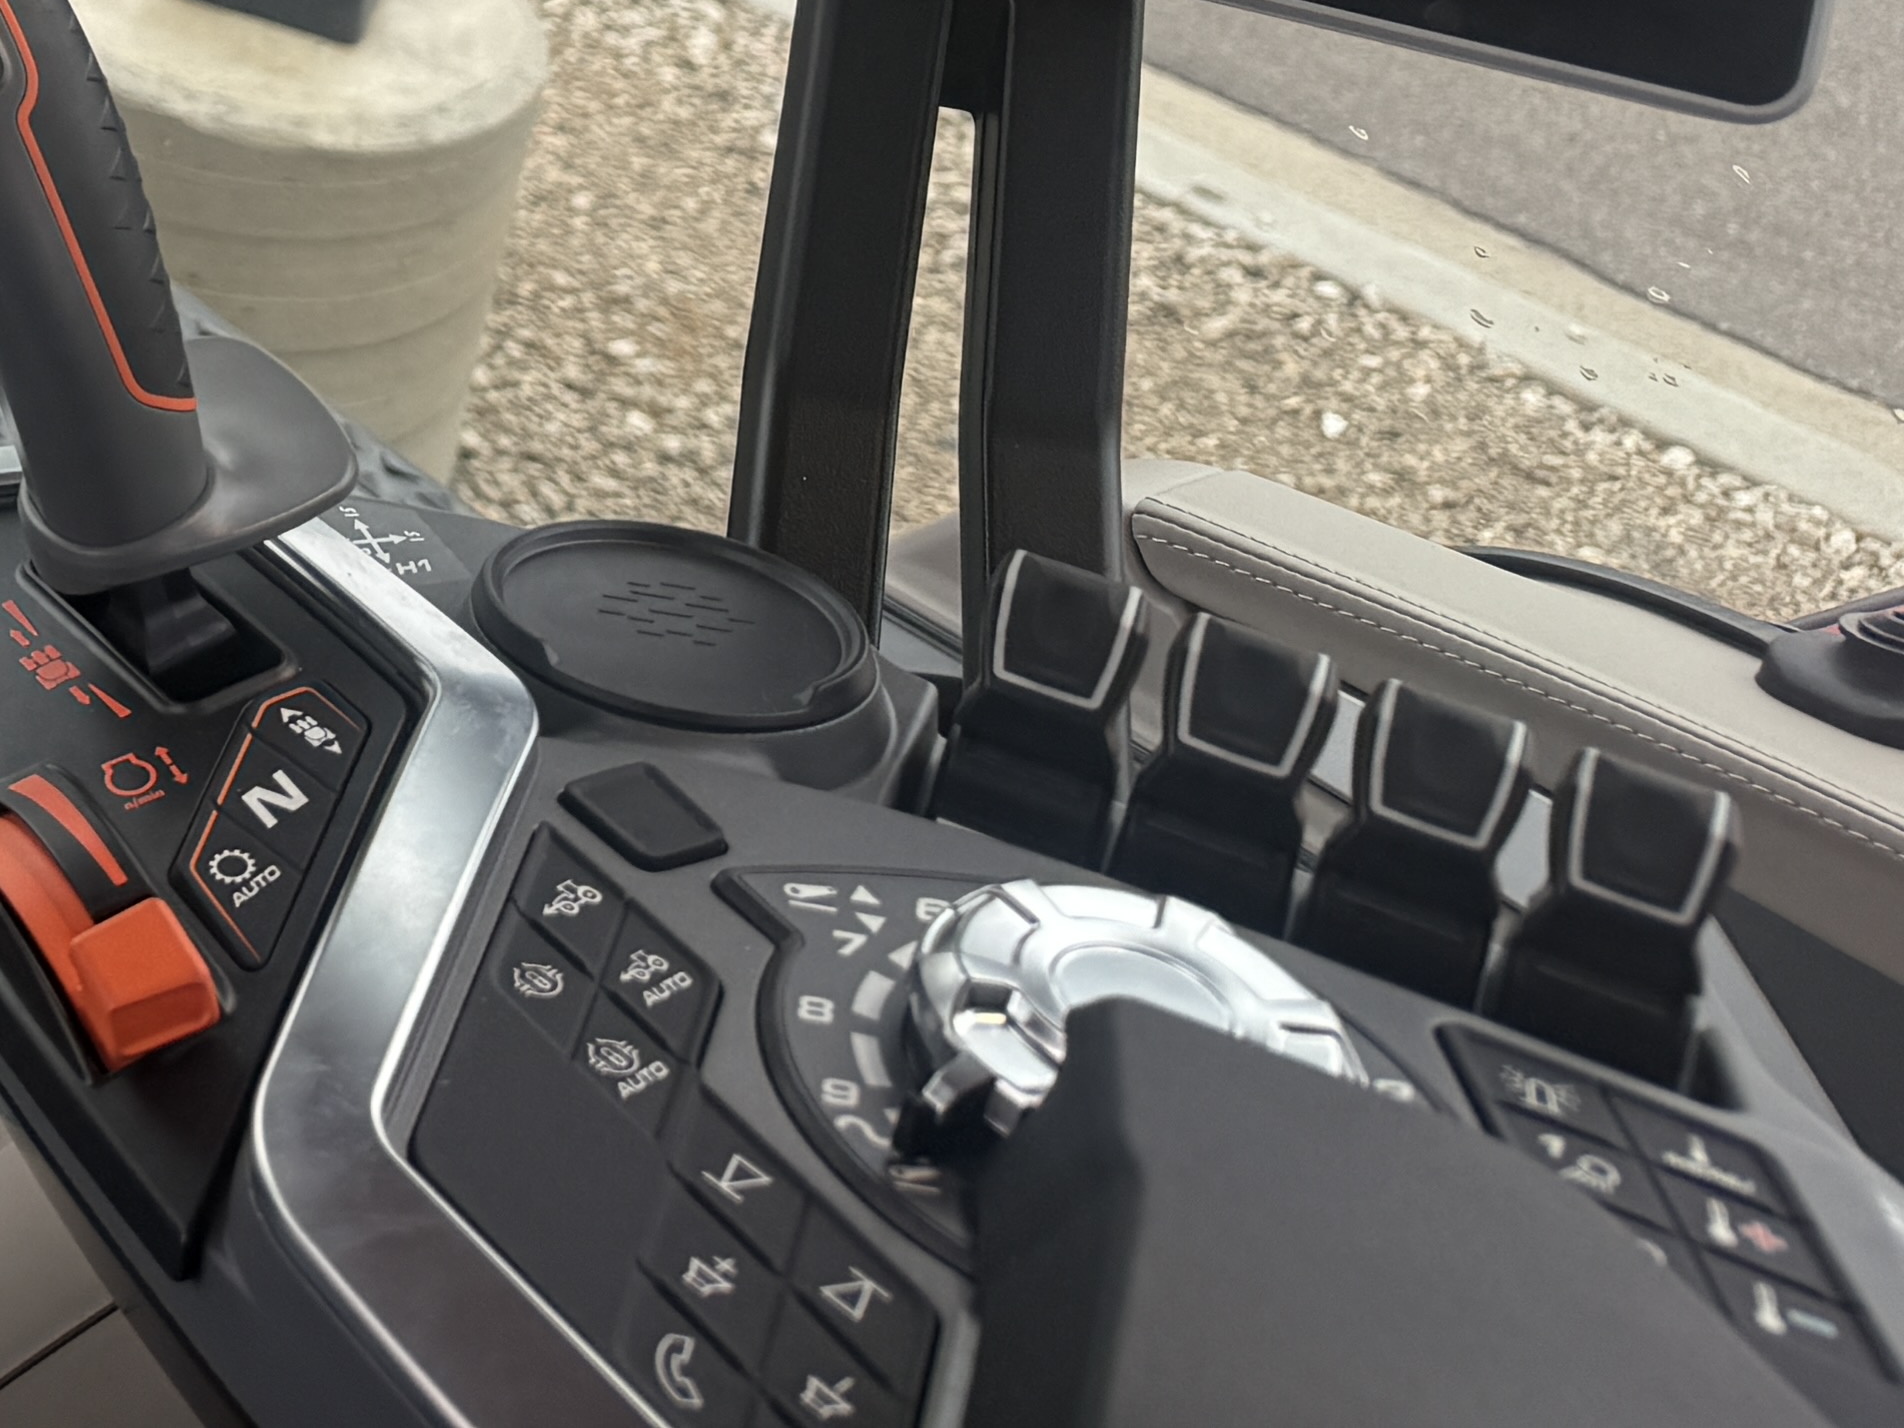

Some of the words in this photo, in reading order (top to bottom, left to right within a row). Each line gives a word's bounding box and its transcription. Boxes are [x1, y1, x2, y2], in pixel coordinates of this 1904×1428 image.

[241, 769, 310, 830] N
[231, 863, 282, 908] AUTO
[642, 971, 693, 1008] AUTO
[797, 994, 835, 1025] 8
[617, 1059, 671, 1101] AUTO
[820, 1076, 861, 1108] 9
